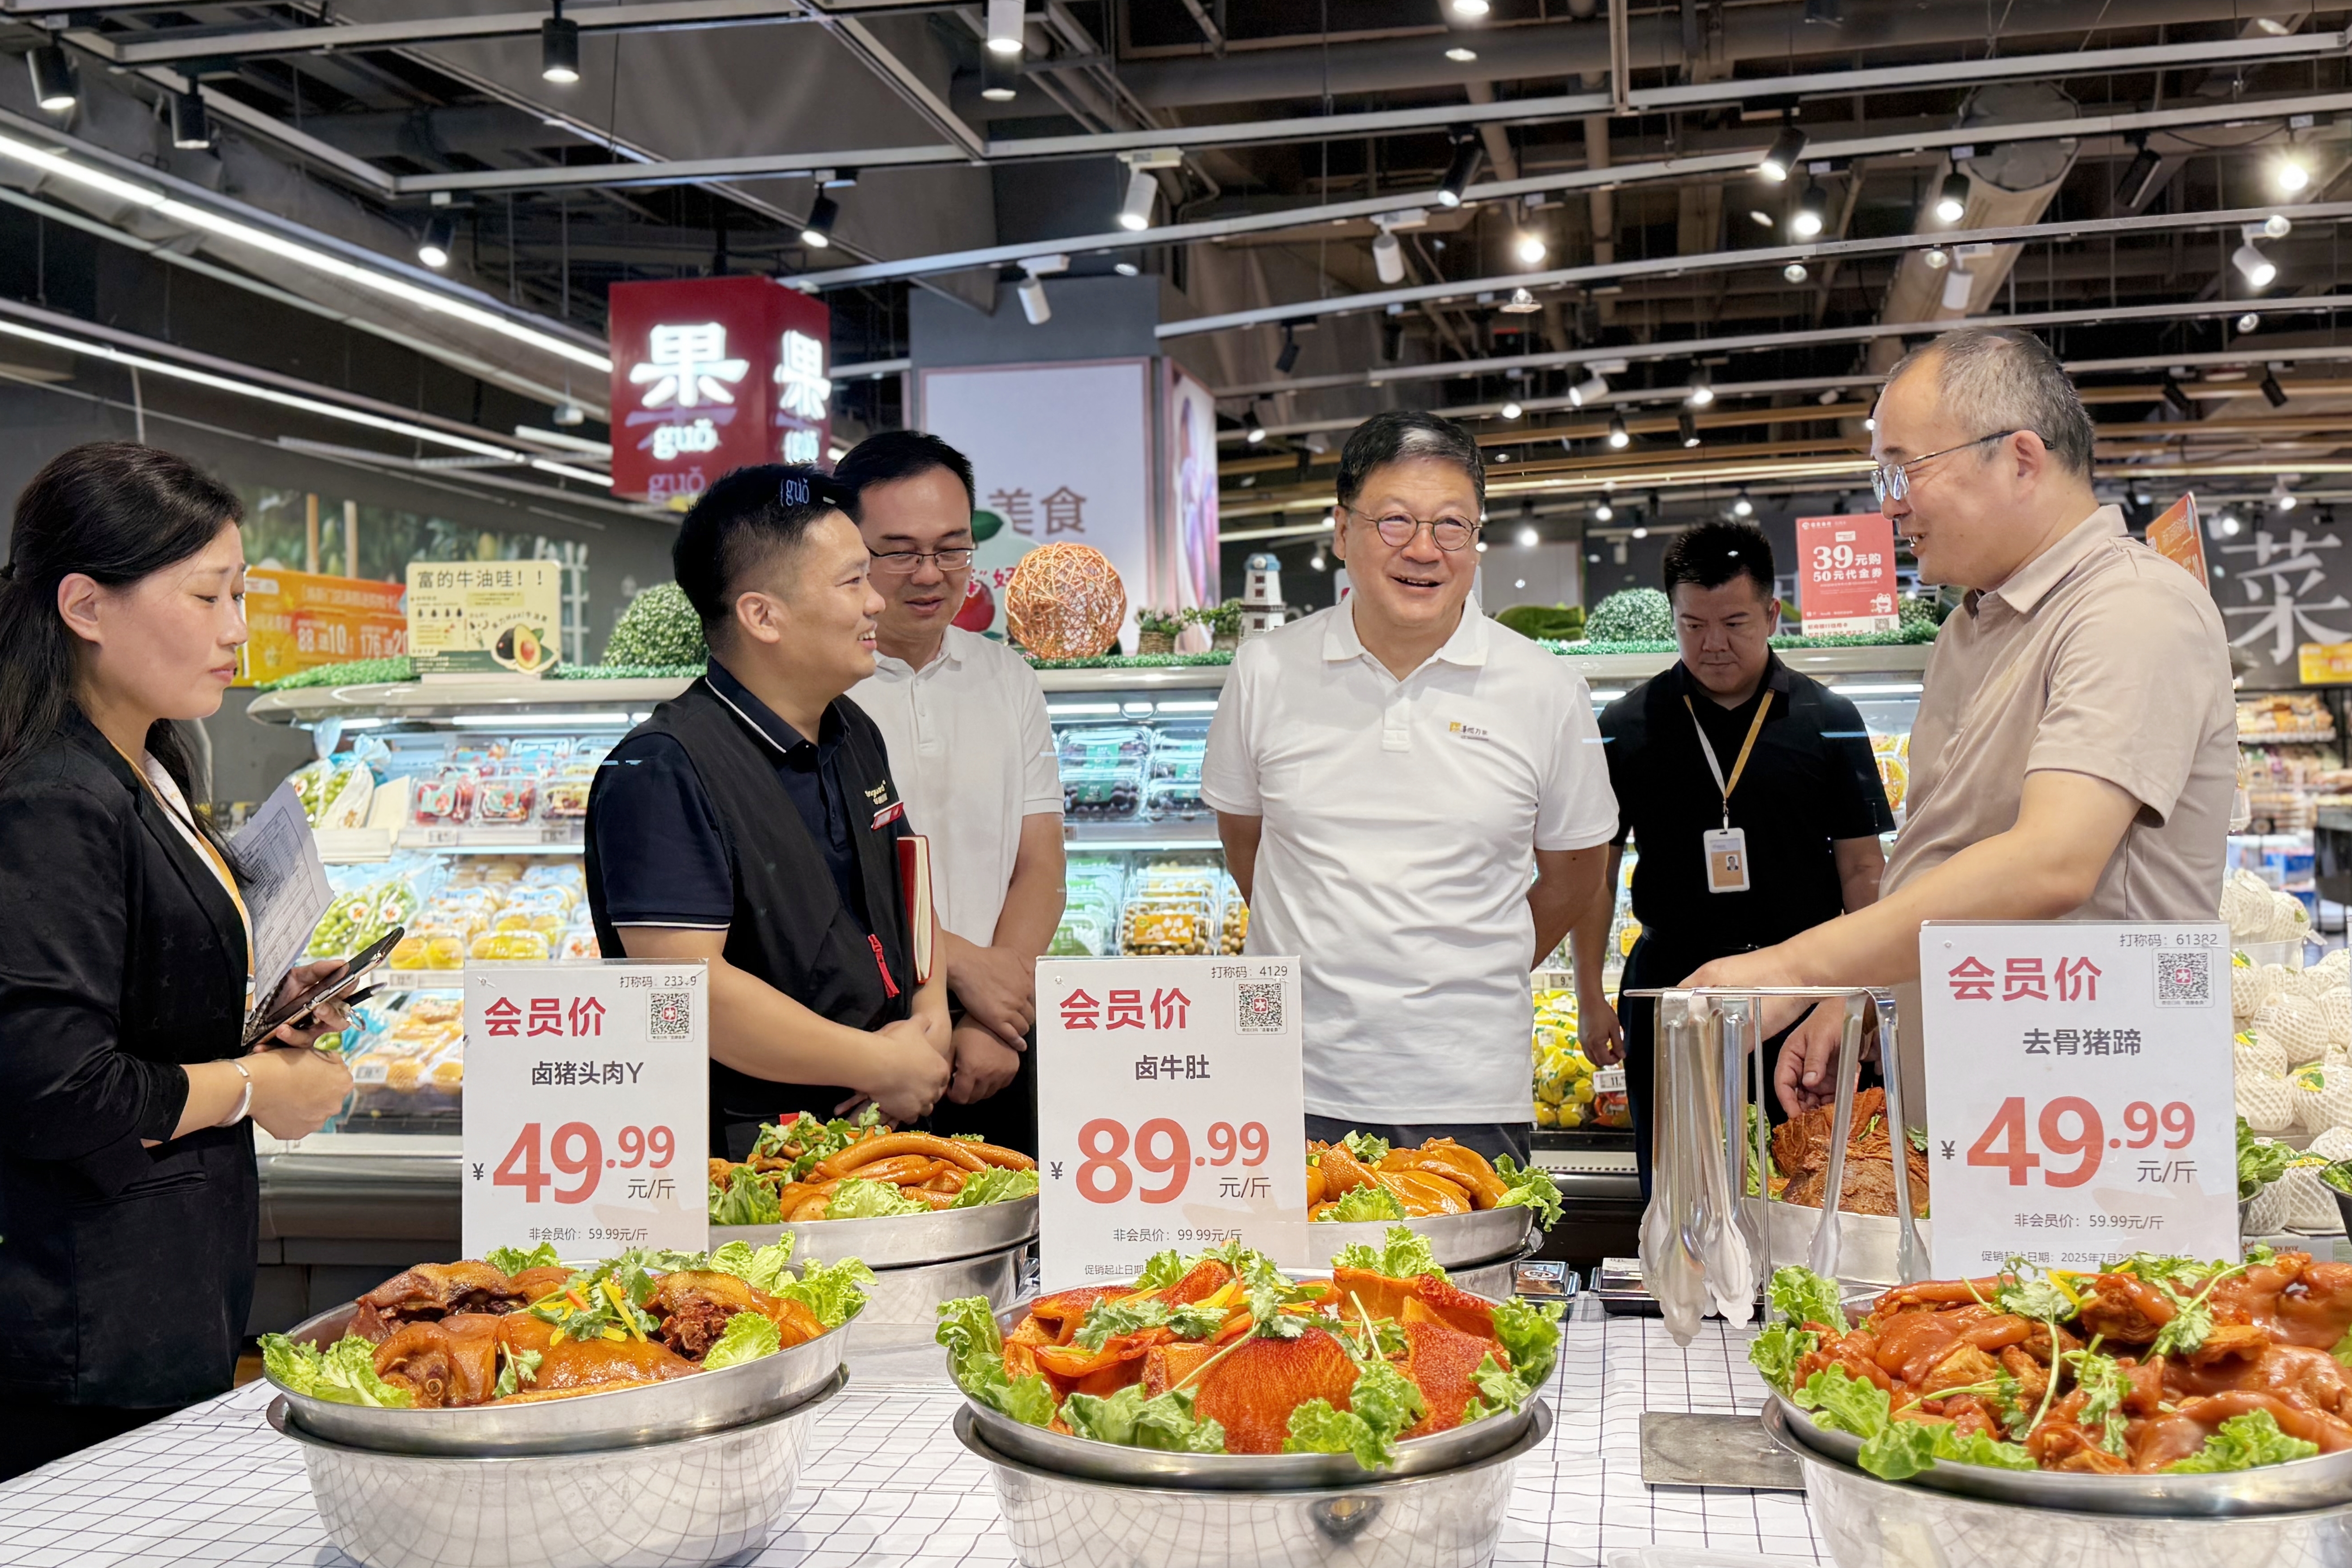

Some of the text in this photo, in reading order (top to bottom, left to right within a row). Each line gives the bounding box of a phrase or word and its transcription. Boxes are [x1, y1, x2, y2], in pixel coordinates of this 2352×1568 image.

[629, 322, 750, 407] 果
[773, 330, 832, 420] 果
[988, 485, 1087, 536] 美食
[1813, 545, 1881, 570] 39元购
[1813, 568, 1882, 582] 50元代金券
[2221, 529, 2352, 665] 菜
[620, 976, 696, 988] 打称码：2339
[1212, 966, 1287, 978] 打称码：4129
[1949, 956, 2102, 1001] 会员价
[485, 997, 606, 1037] 会员价
[1060, 988, 1191, 1030] 会员价
[2023, 1028, 2141, 1056] 去骨猪蹄
[1135, 1054, 1211, 1080] 卤牛肚
[1967, 1096, 2195, 1188] 49.99
[493, 1121, 675, 1204] 49.99
[1076, 1118, 1269, 1204] 89.99
[2137, 1161, 2198, 1184] 元/斤
[628, 1179, 676, 1200] 元/斤
[1219, 1177, 1271, 1199] 元/斤
[529, 1227, 648, 1241] 非会员价：59.99元/斤
[1113, 1228, 1243, 1242] 非会员价：99.99元/斤
[2014, 1213, 2164, 1231] 非会员价：59.99元/斤
